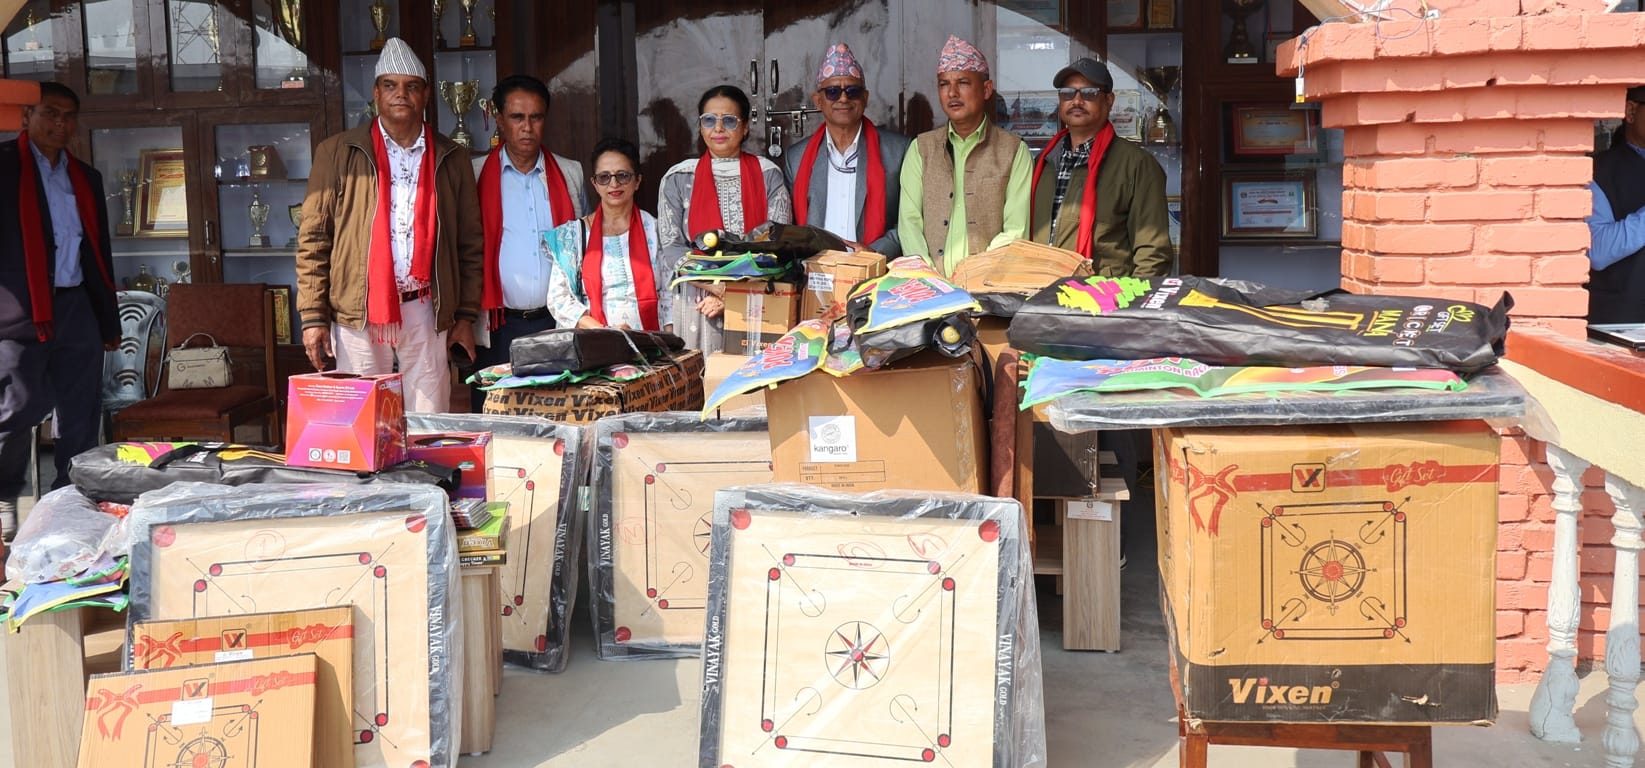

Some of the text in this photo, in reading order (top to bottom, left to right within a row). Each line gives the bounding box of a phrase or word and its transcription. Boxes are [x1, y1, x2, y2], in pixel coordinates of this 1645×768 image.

[515, 391, 566, 407] Vixen
[571, 408, 618, 421] Vixe
[814, 445, 847, 454] kangaro
[1391, 466, 1435, 487] Gift Set
[555, 523, 568, 562] VINAYAK
[430, 605, 443, 655] VINAYAK
[706, 615, 720, 684] VINAYAK GOLD
[998, 634, 1012, 706] VINAYAK GOLD
[1228, 677, 1334, 704] Vixen
